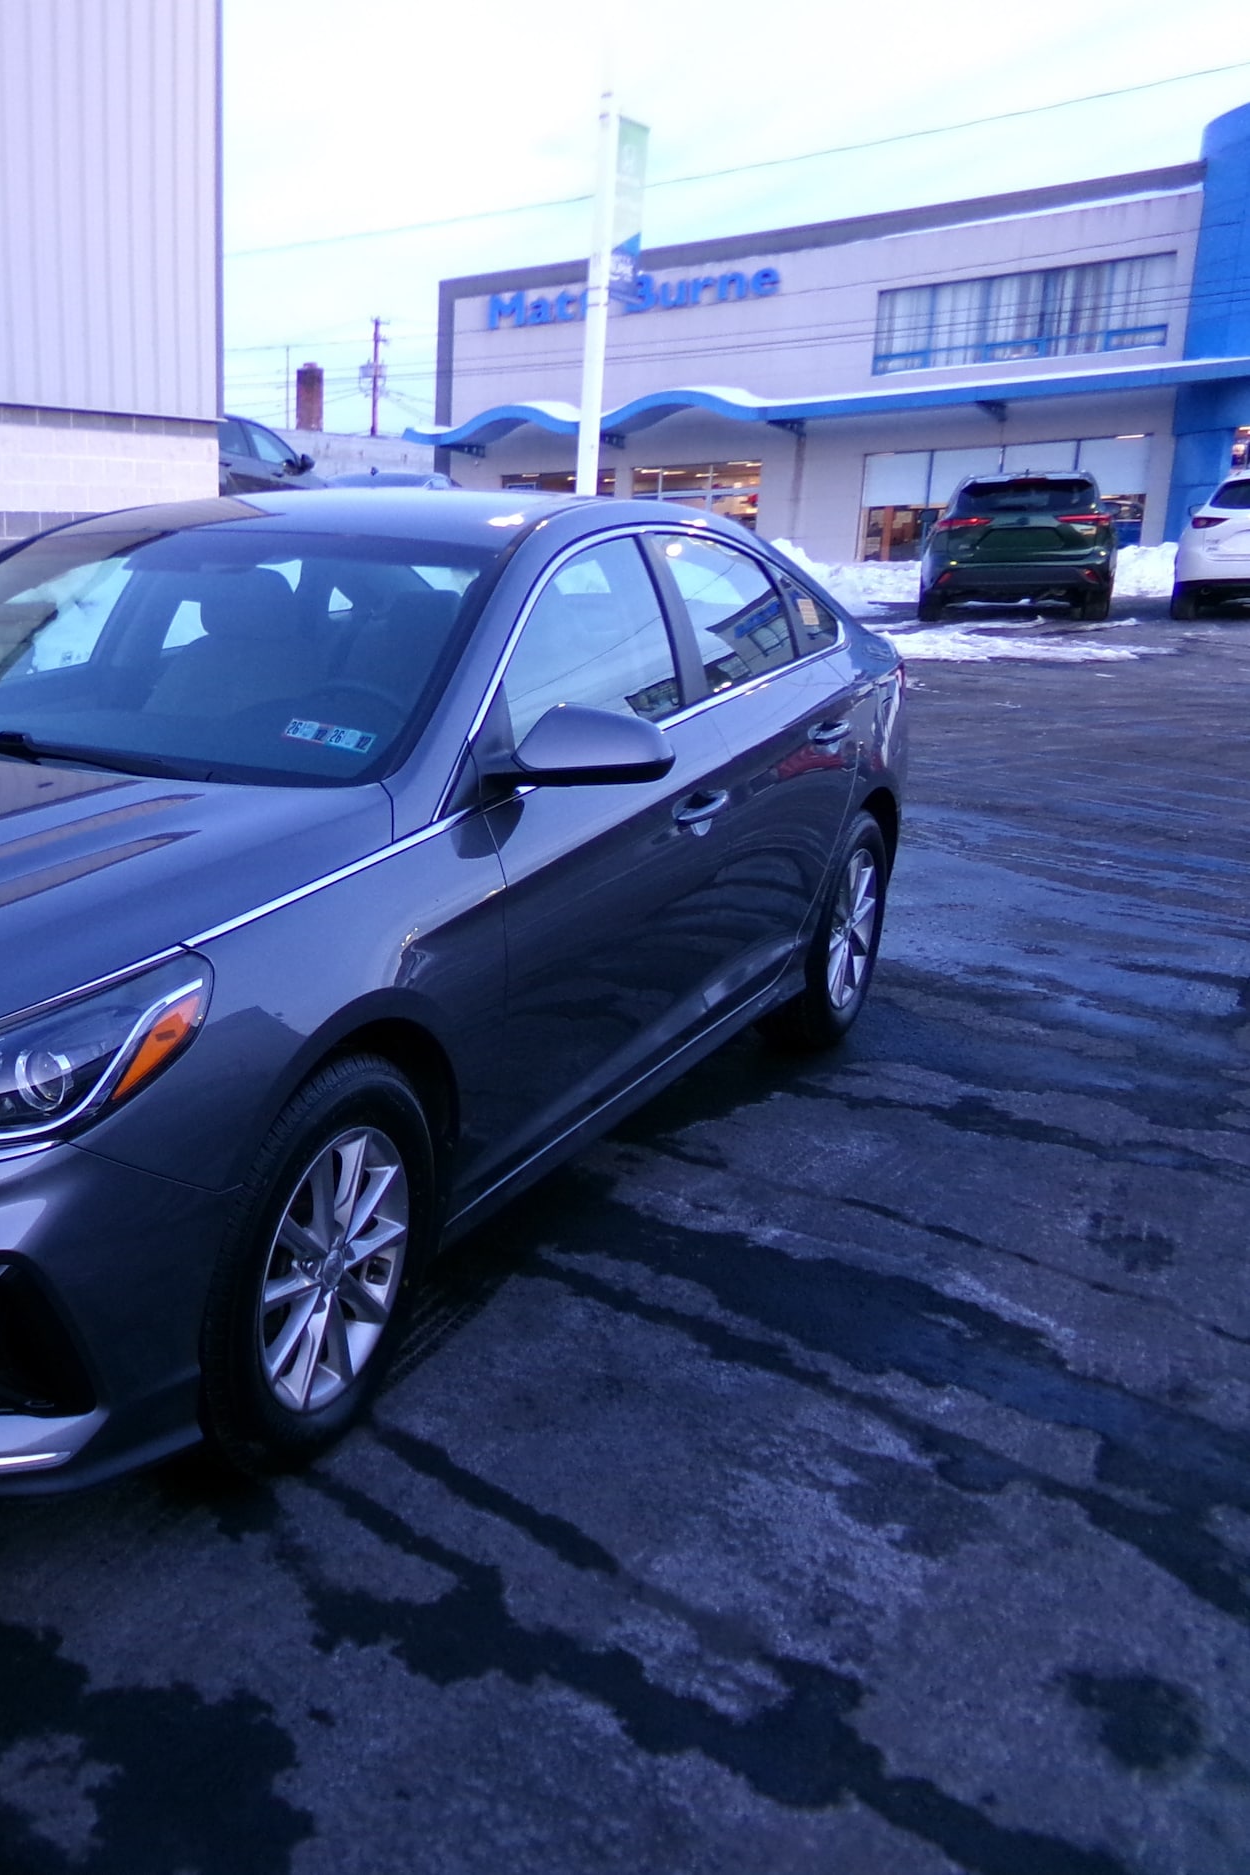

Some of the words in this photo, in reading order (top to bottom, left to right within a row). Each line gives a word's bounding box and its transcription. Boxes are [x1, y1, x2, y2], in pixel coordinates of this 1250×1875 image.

[287, 721, 302, 735] 26
[329, 729, 345, 743] 26
[355, 735, 372, 750] 12
